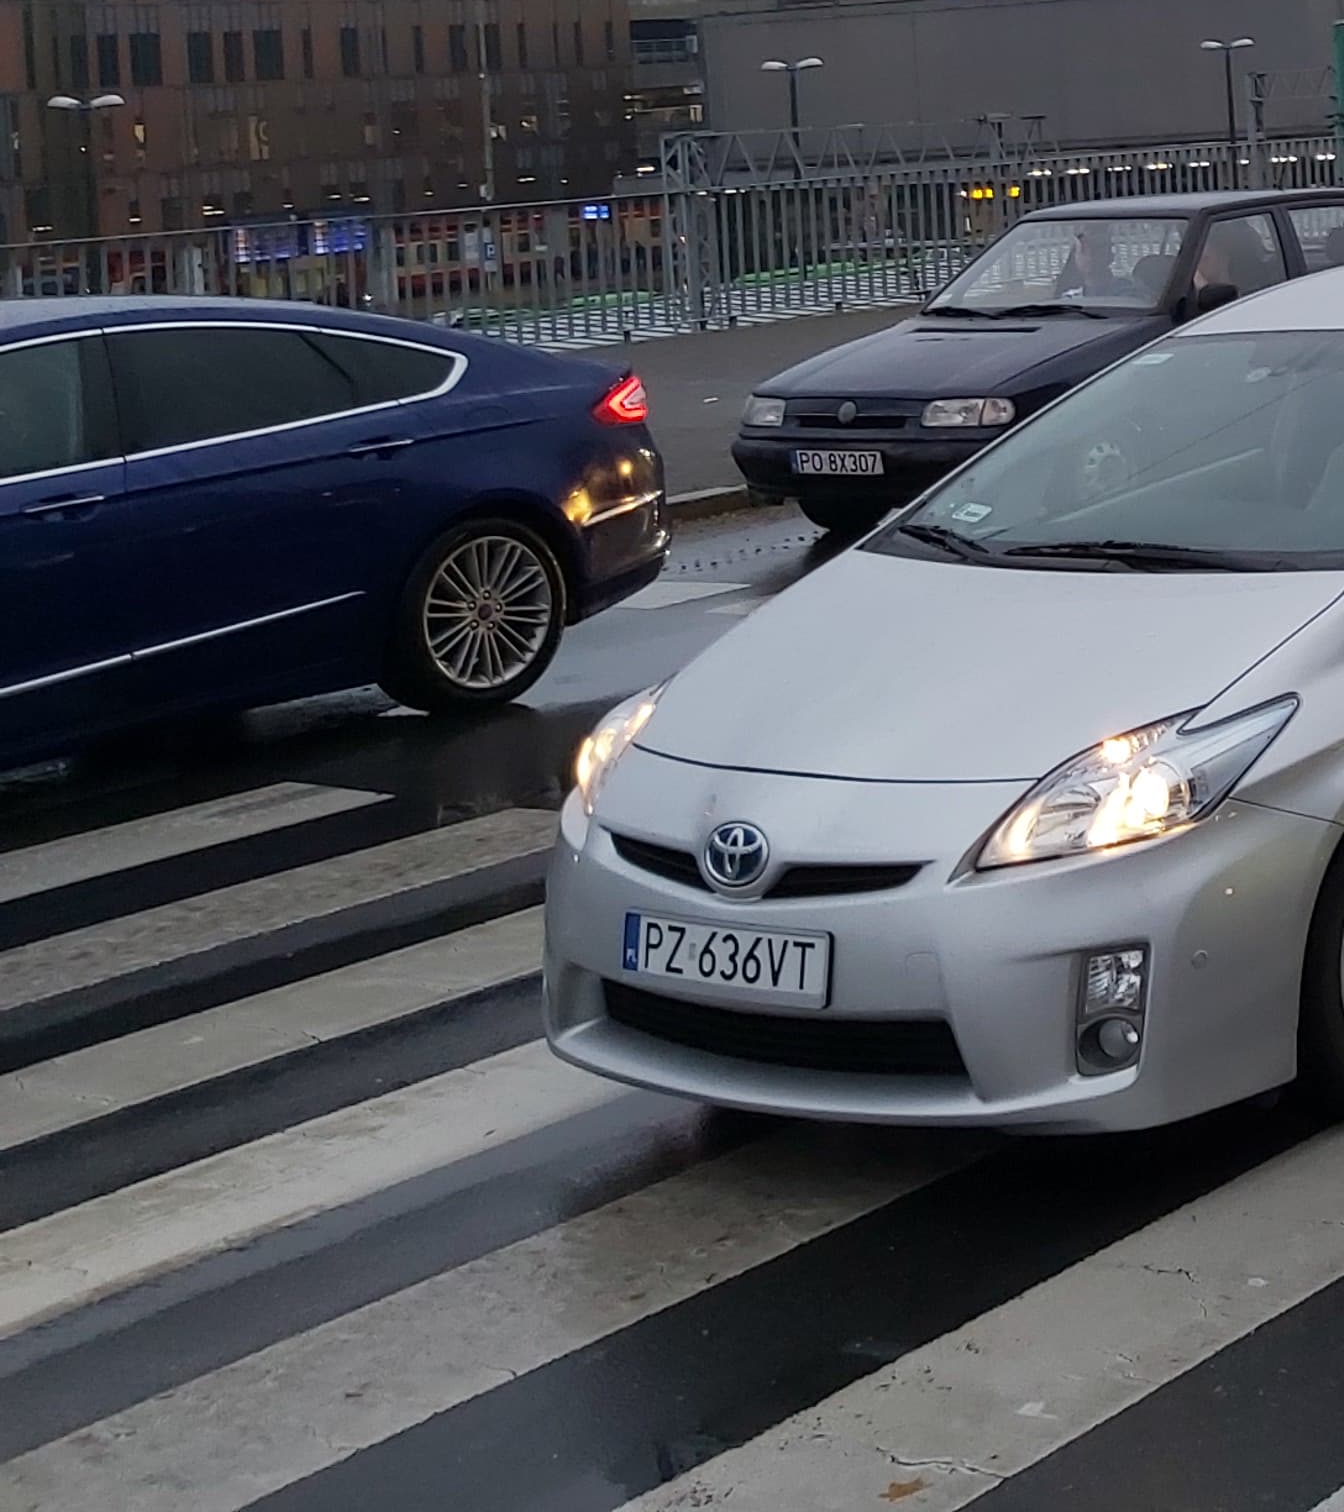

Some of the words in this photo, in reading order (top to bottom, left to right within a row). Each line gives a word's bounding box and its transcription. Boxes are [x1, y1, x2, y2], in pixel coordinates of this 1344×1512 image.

[799, 452, 824, 472] PO
[828, 452, 877, 473] 8X307
[644, 922, 686, 975] PZ
[698, 931, 816, 990] 636VT
